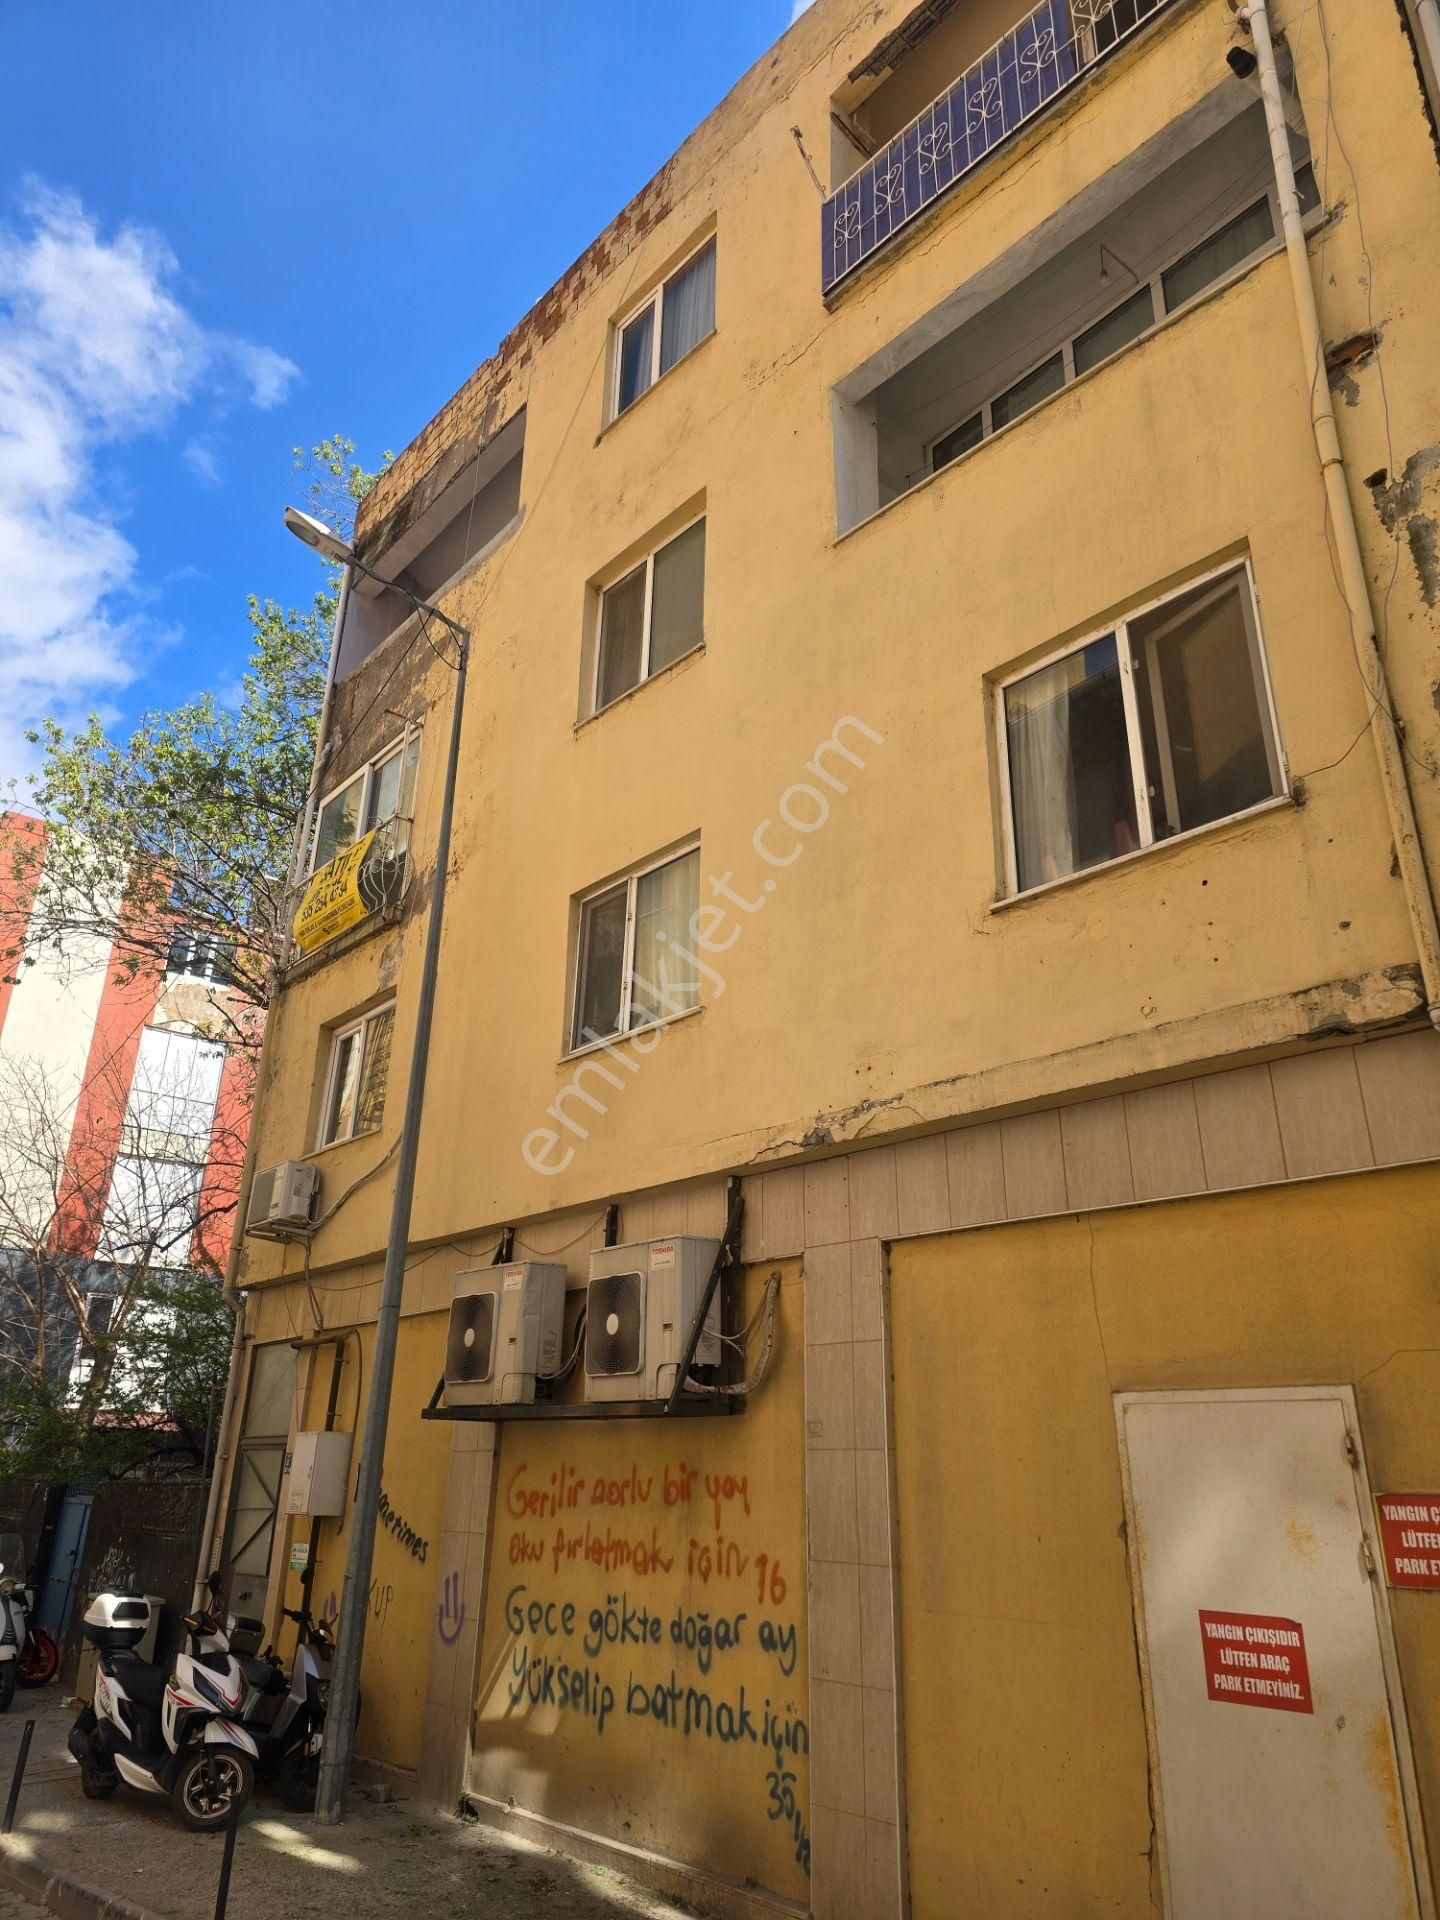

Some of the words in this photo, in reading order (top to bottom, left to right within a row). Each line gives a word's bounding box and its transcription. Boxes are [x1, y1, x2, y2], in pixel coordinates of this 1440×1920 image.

[652, 1246, 674, 1256] TOSHIBA
[508, 1461, 585, 1519] Gerilir
[663, 1462, 698, 1507] bir
[706, 1473, 750, 1531] yay
[1382, 1504, 1430, 1522] YANGIN
[688, 1536, 750, 1584] için
[754, 1553, 788, 1606] 16
[1394, 1557, 1430, 1576] PARK
[504, 1584, 576, 1636] Gece
[583, 1591, 662, 1658] gökte
[670, 1607, 747, 1675] doğar
[758, 1620, 798, 1677] ay
[1204, 1622, 1245, 1641] YANGIN
[1245, 1626, 1301, 1648] ÇIKIŞIDIR
[1220, 1647, 1259, 1668] LÜTFEN
[1259, 1653, 1291, 1675] ARAÇ
[1213, 1673, 1243, 1692] PARK
[1243, 1677, 1305, 1700] ETMEYİNİZ.
[627, 1668, 757, 1743] batmak
[762, 1699, 810, 1769] için
